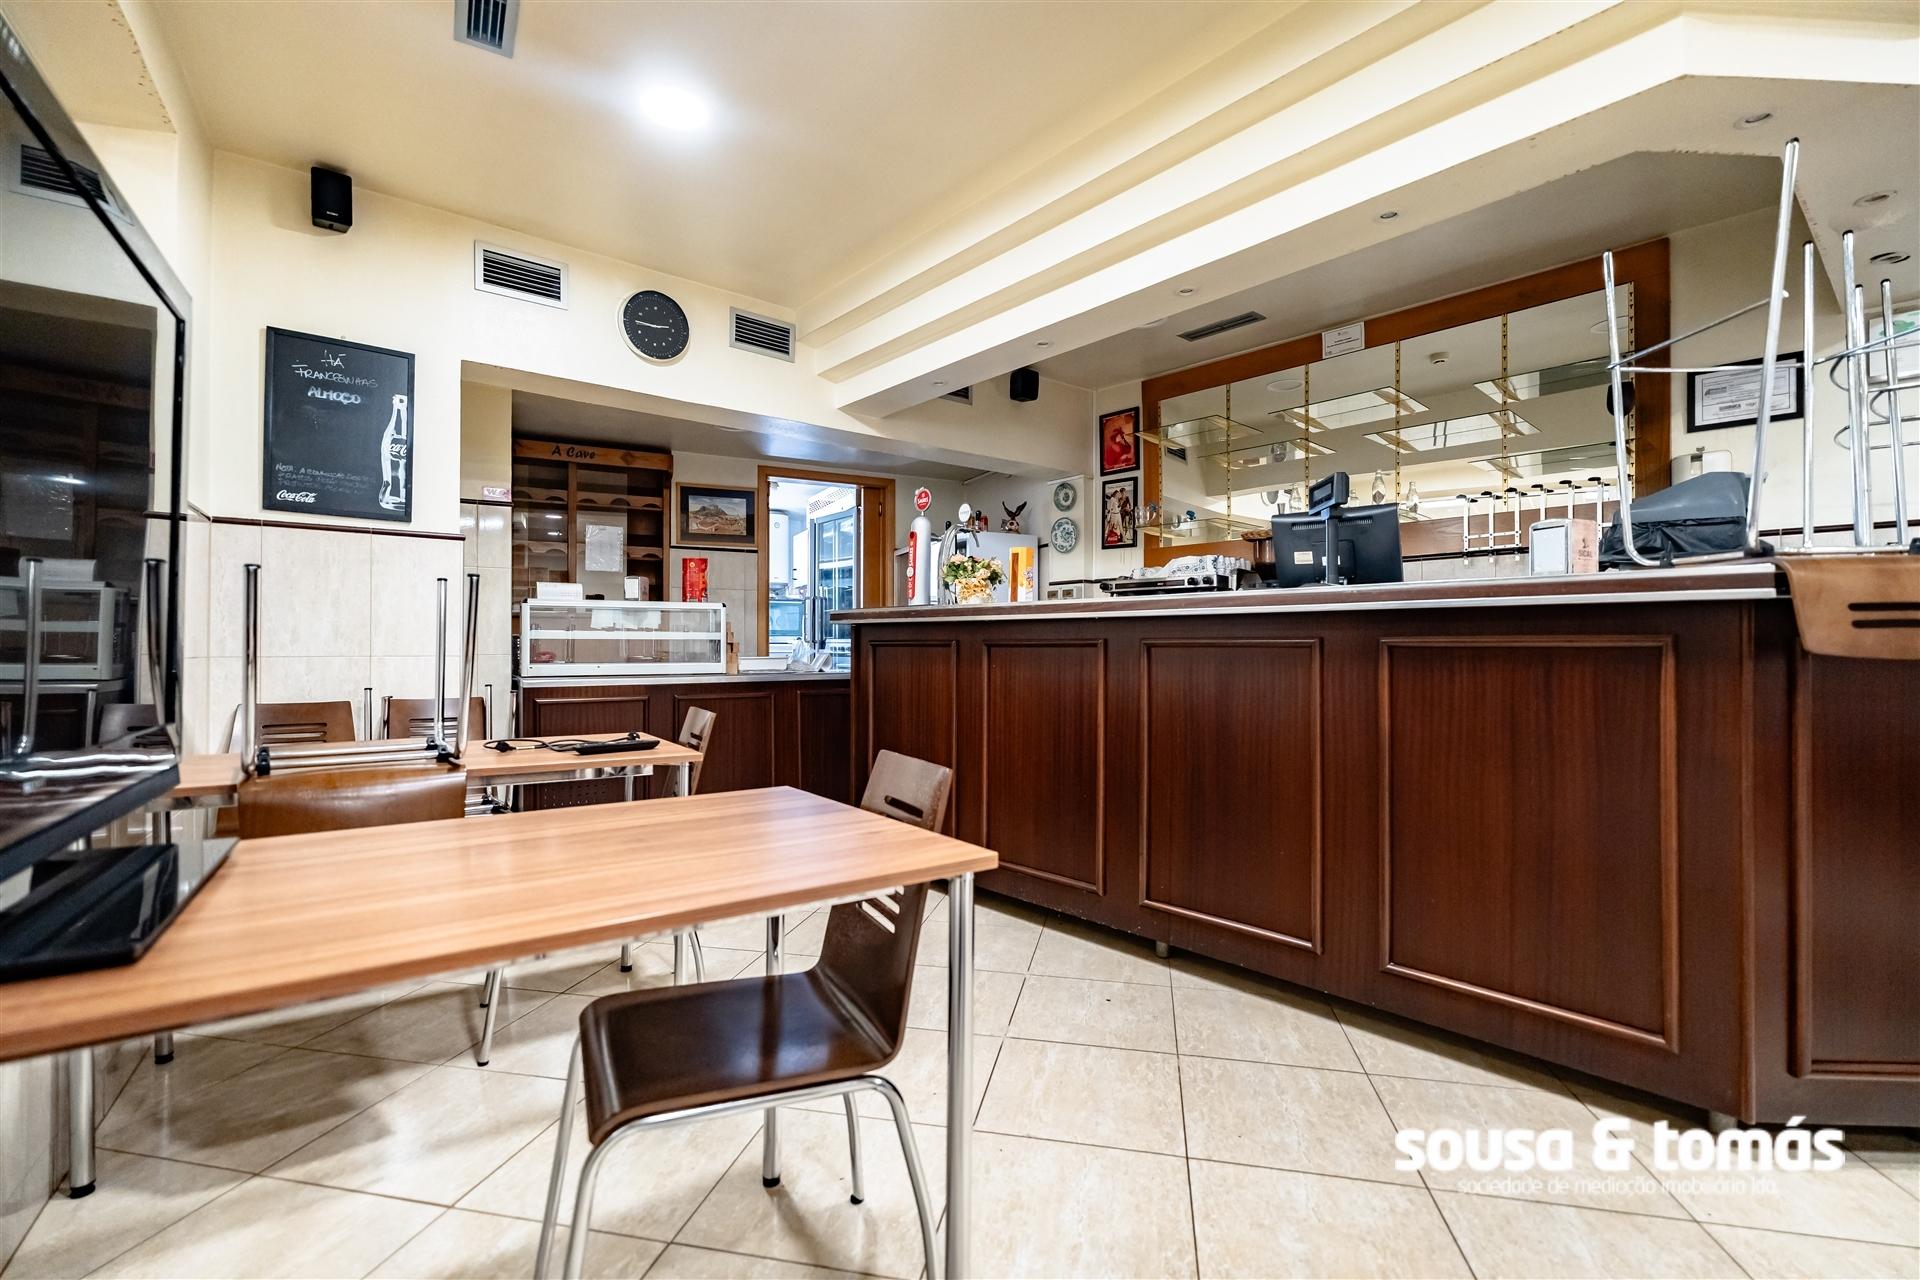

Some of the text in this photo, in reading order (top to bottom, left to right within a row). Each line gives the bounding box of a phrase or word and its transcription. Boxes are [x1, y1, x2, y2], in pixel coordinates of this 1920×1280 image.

[308, 386, 361, 404] ALMOÇO
[551, 445, 596, 459] A Cave
[276, 489, 318, 503] Coca-Cola
